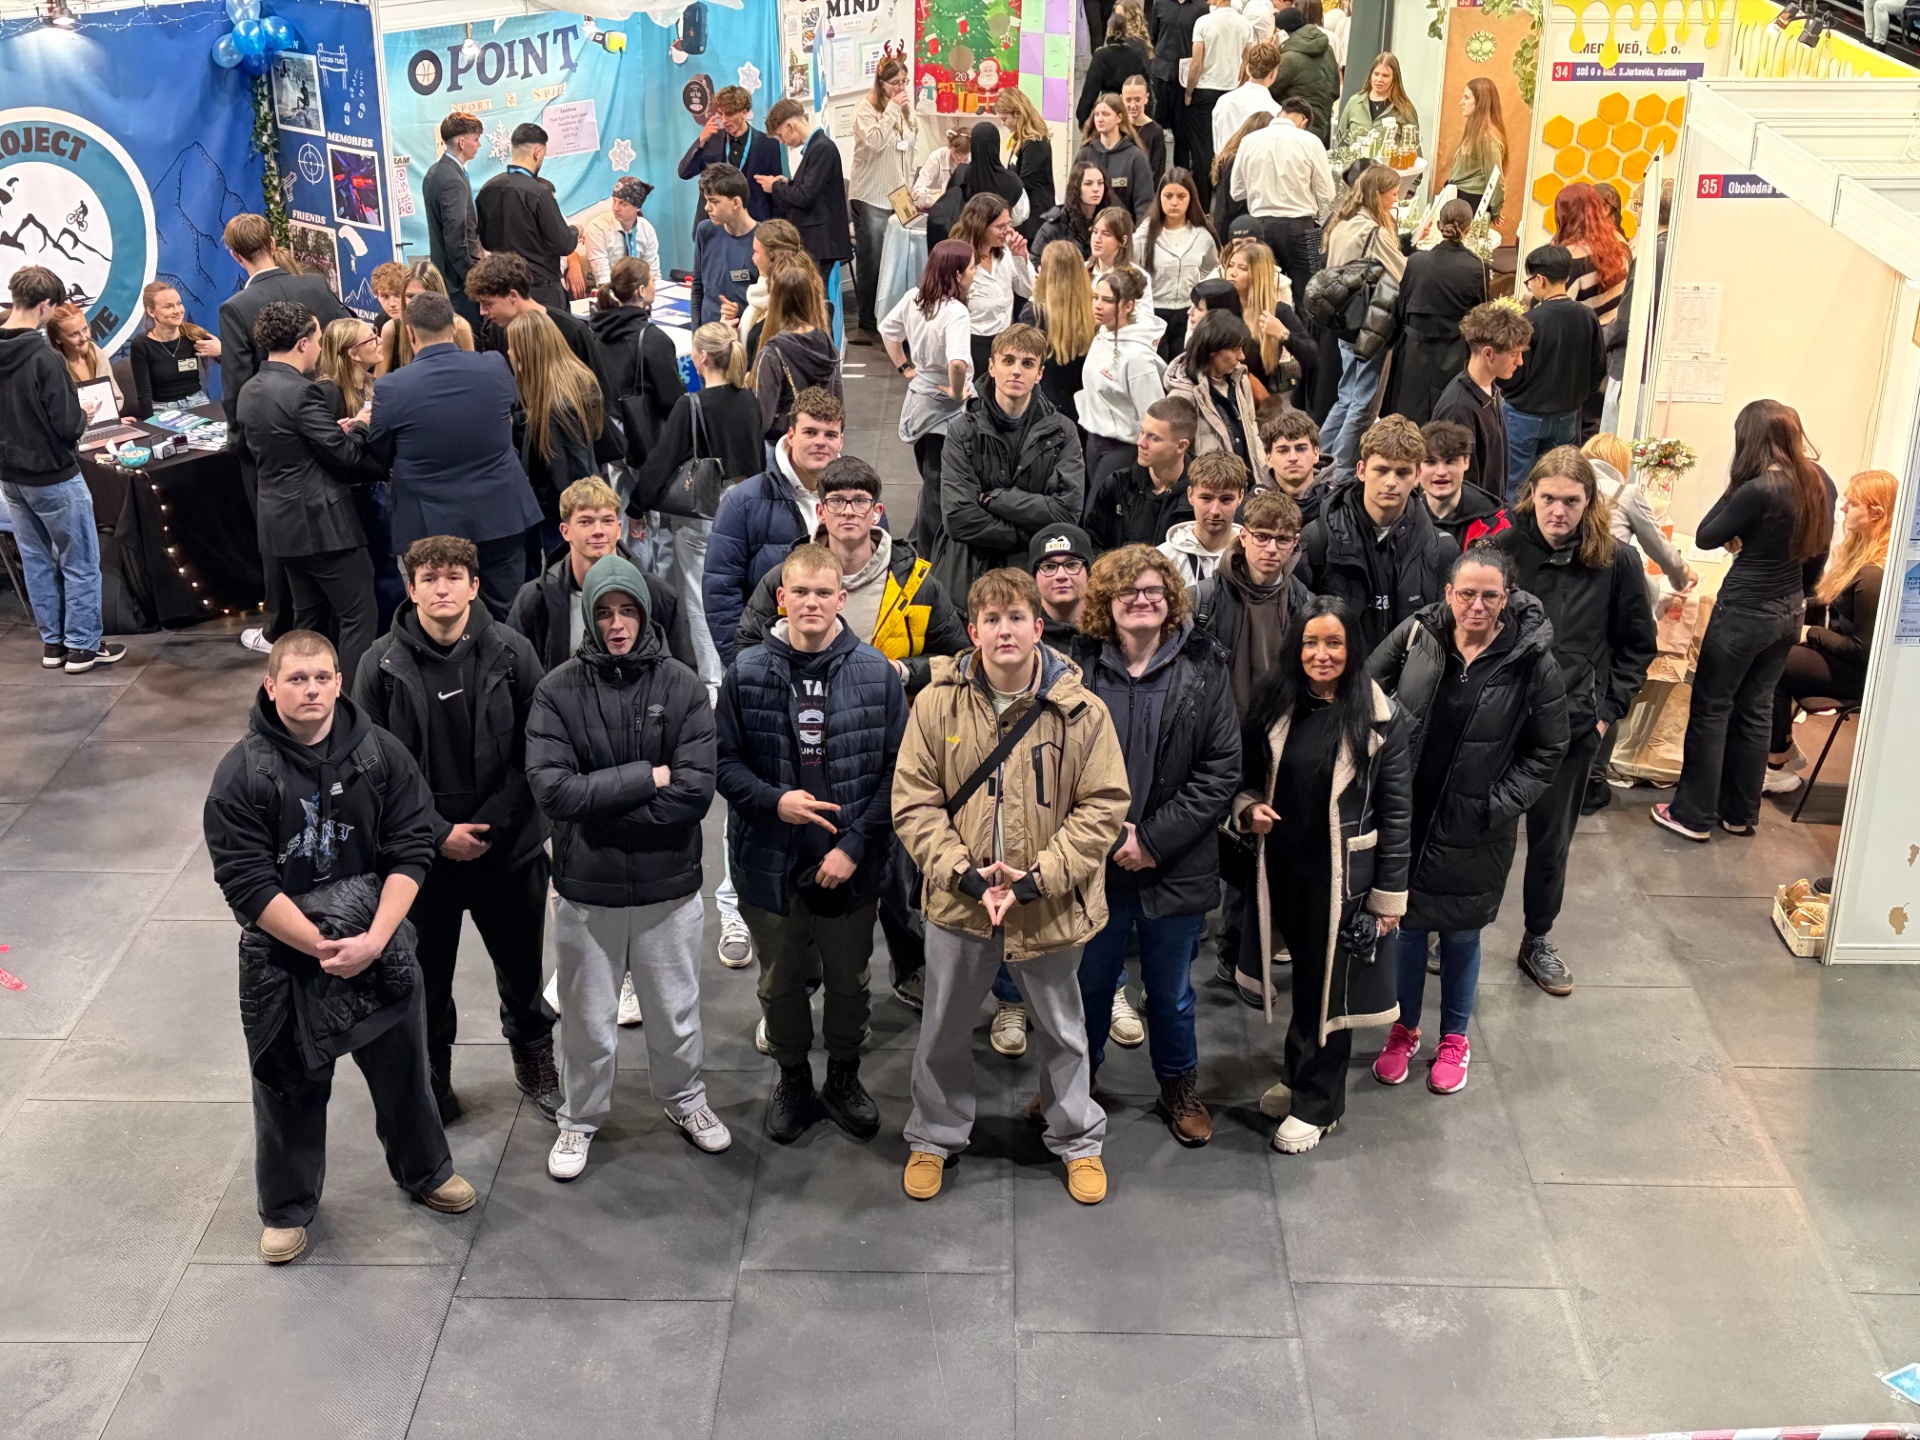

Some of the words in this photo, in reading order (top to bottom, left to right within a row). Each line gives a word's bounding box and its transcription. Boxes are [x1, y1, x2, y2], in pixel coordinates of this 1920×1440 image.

[955, 72, 968, 82] 20
[1555, 65, 1569, 79] 34
[1656, 67, 1687, 77] Bratislava
[0, 127, 87, 162] OJECT
[327, 131, 374, 148] MEMORIES
[1701, 179, 1718, 194] 35
[292, 209, 327, 225] FRIENDS
